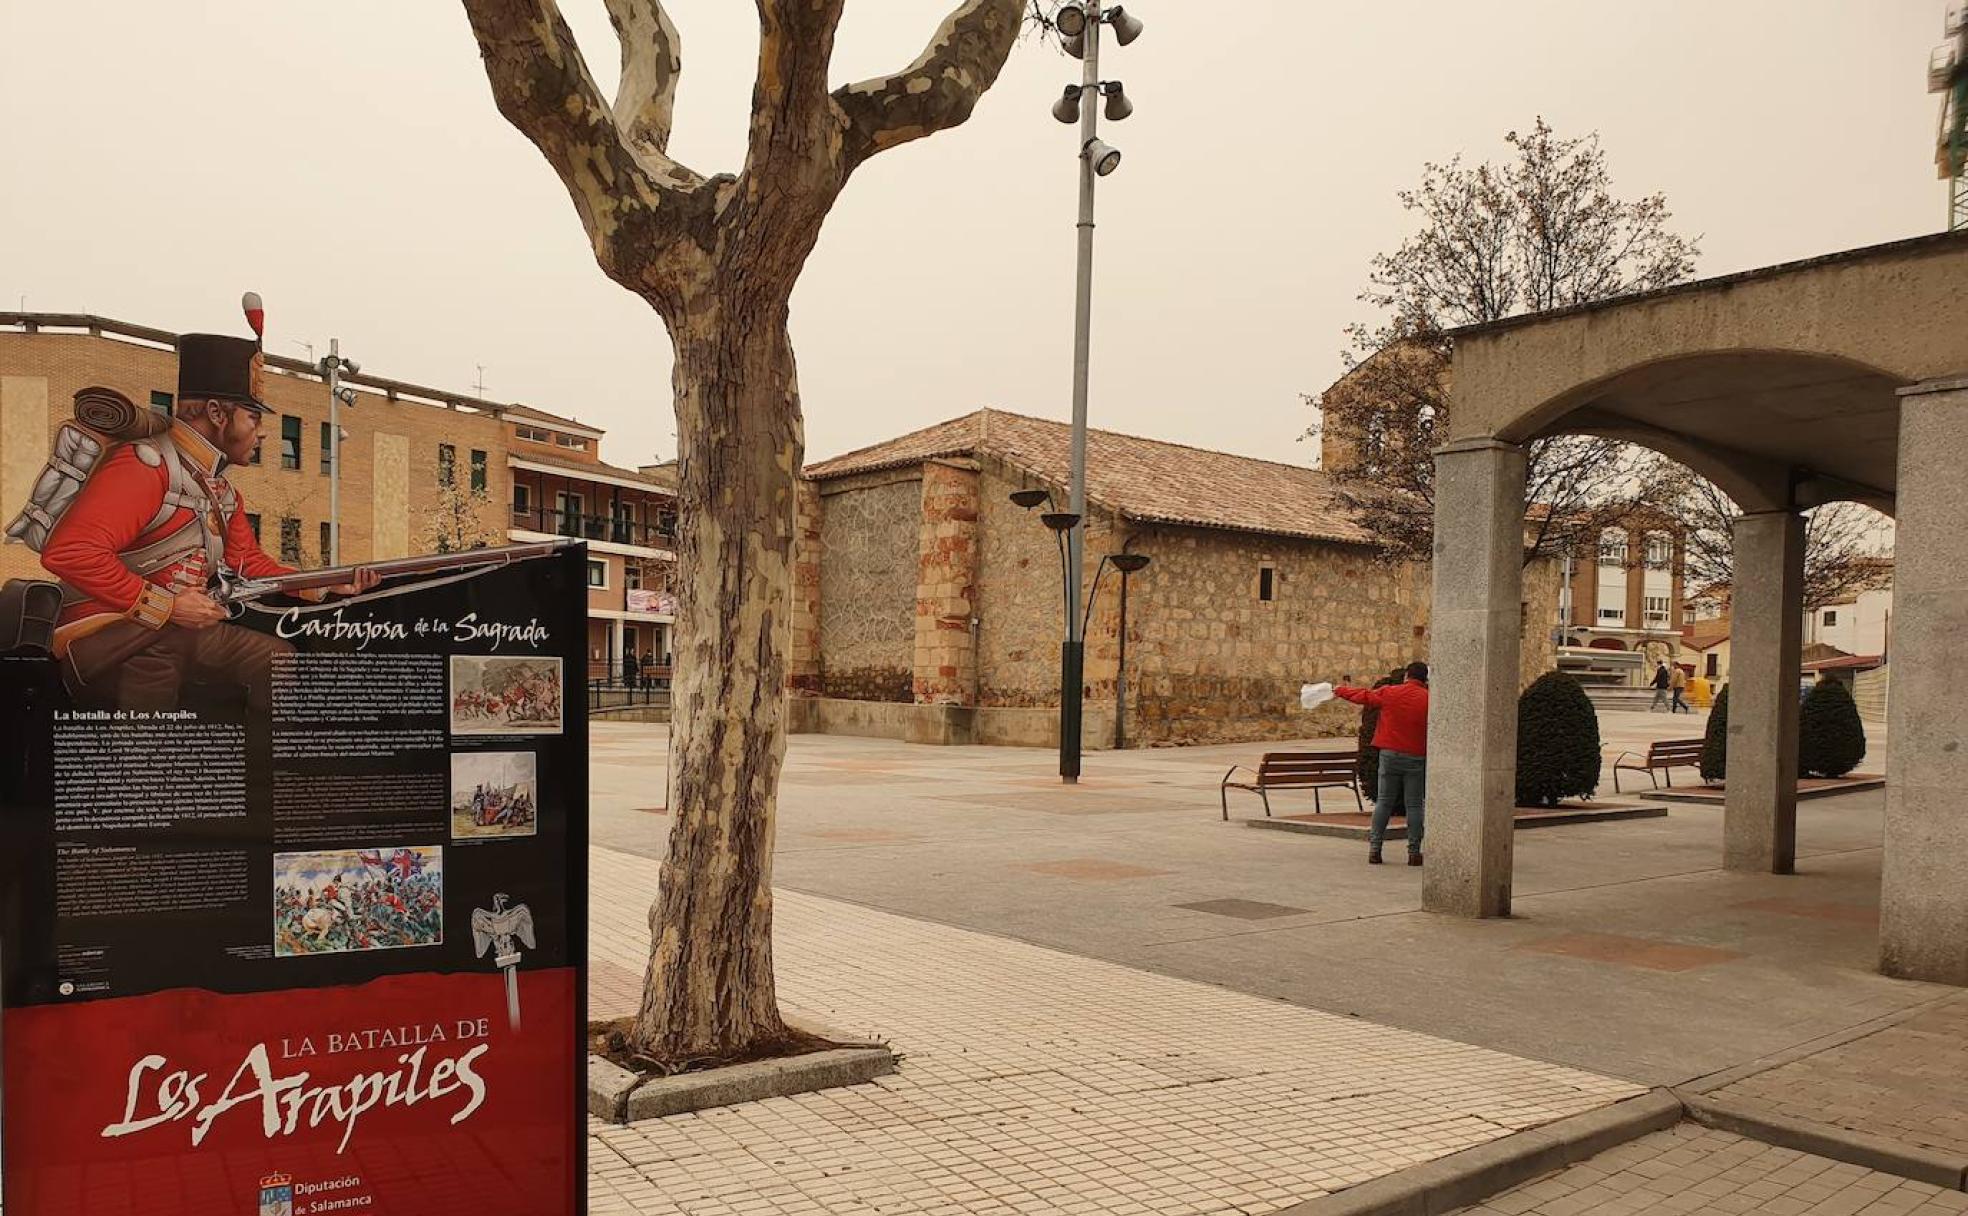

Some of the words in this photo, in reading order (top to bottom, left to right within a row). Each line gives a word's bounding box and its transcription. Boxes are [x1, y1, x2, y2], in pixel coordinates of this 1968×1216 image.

[275, 606, 408, 651] Carbajosa
[414, 617, 429, 637] de
[433, 618, 449, 633] la
[453, 612, 550, 651] Sagrada
[53, 710, 69, 720] La
[72, 709, 111, 720] batalla
[113, 710, 127, 720] de
[130, 710, 150, 720] Los
[152, 710, 197, 722] Arapiles
[281, 1038, 316, 1059] LA
[328, 1024, 446, 1054] BATALLA
[456, 1018, 490, 1038] DE
[101, 1054, 208, 1138] Los
[191, 1042, 489, 1155] Arapiles
[295, 1176, 360, 1196] Diputación
[294, 1206, 307, 1215] de
[310, 1195, 373, 1214] Salamanca
